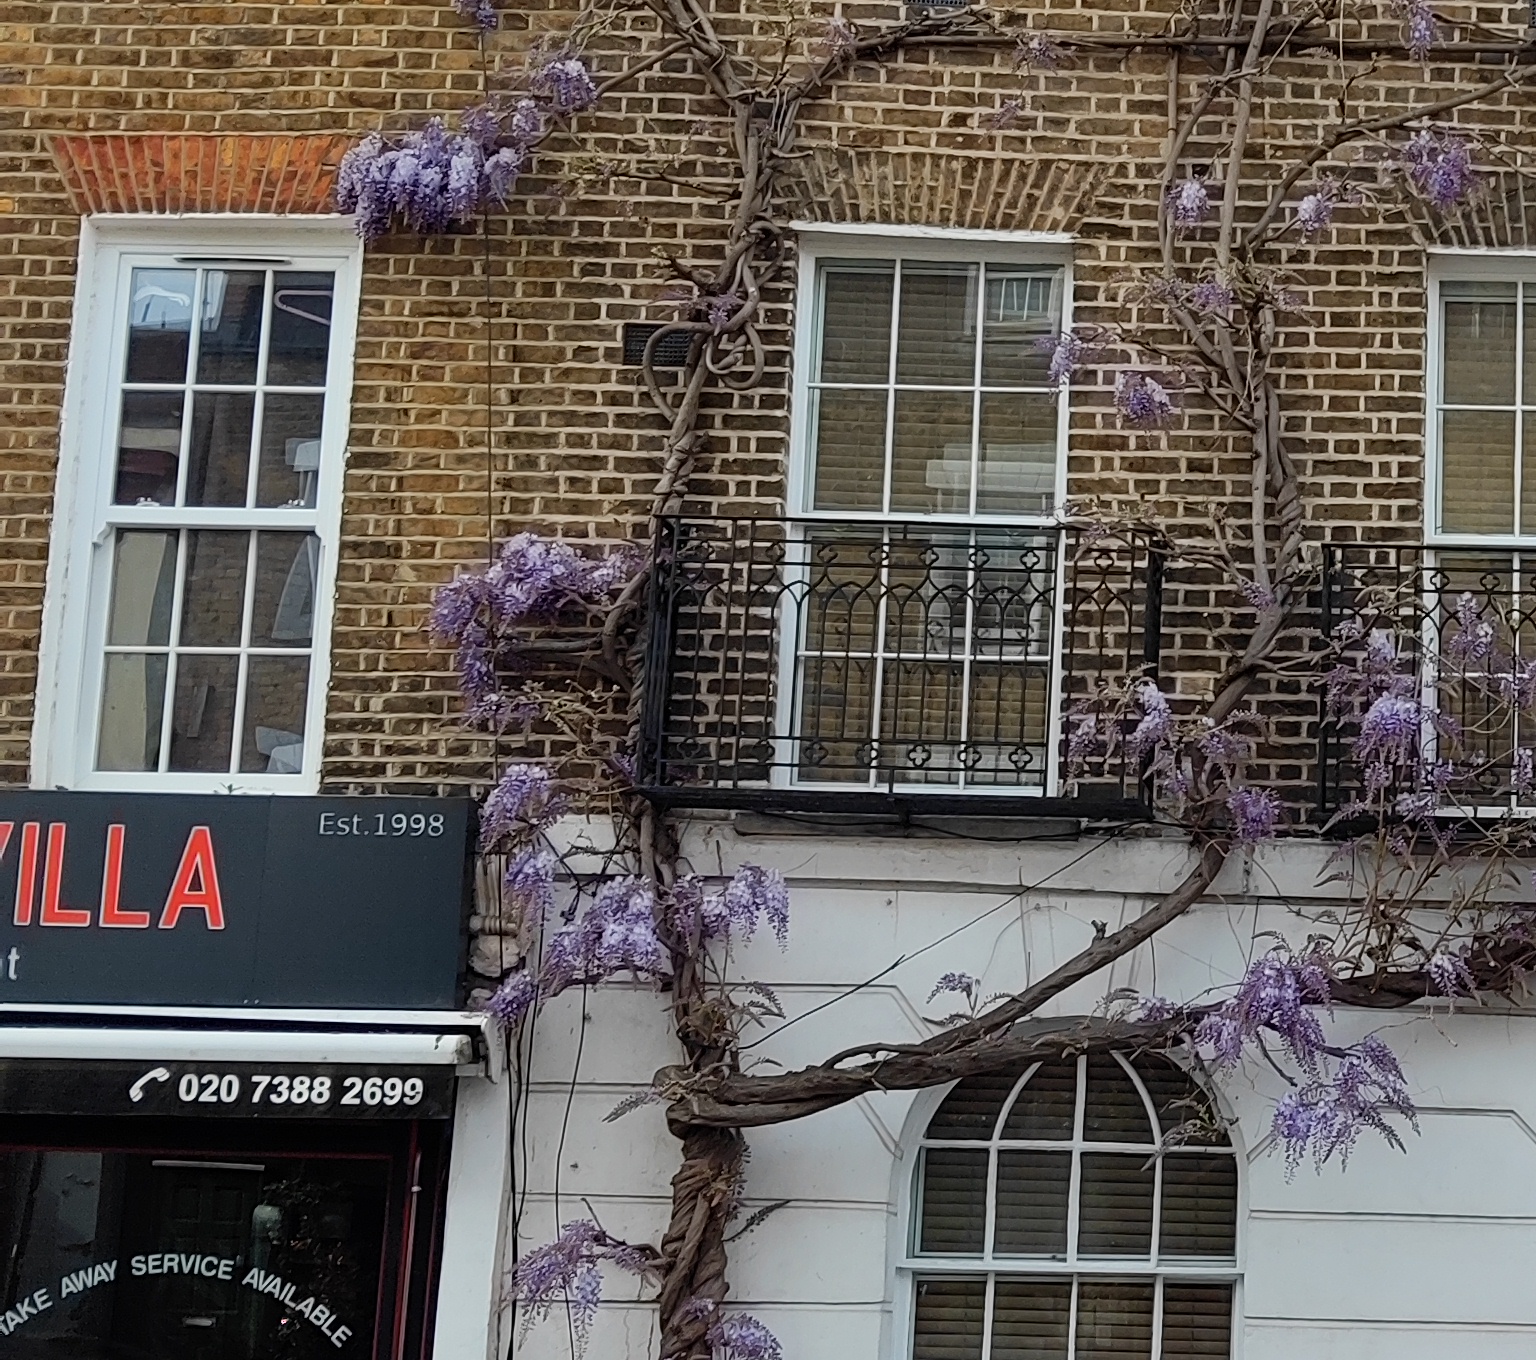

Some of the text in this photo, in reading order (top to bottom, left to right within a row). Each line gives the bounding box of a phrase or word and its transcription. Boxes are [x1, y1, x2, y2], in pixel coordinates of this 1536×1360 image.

[318, 811, 445, 838] Est.1998
[178, 1072, 425, 1107] 020 7388 2699
[60, 1259, 118, 1300] AWAY
[130, 1253, 234, 1281] SERVICE
[241, 1266, 353, 1350] AVAILABLE
